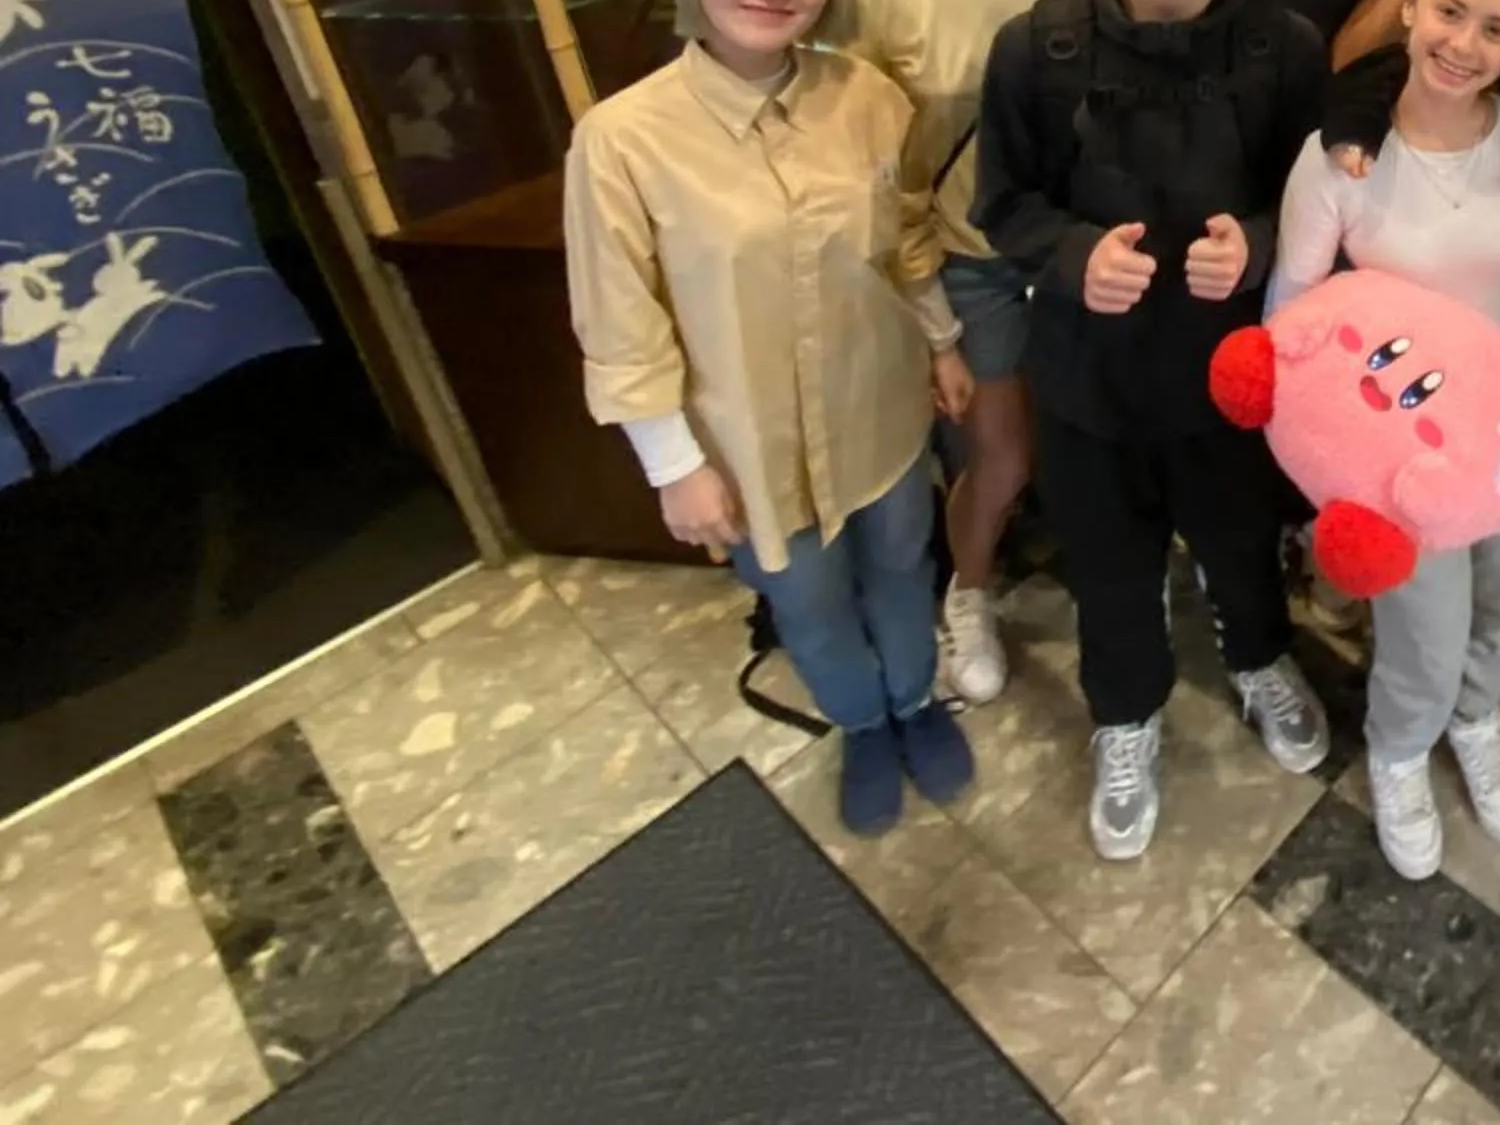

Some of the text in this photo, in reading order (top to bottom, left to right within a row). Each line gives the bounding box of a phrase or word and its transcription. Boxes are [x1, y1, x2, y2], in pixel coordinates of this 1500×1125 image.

[55, 46, 174, 143] 七福
[26, 91, 111, 225] うさぎ
